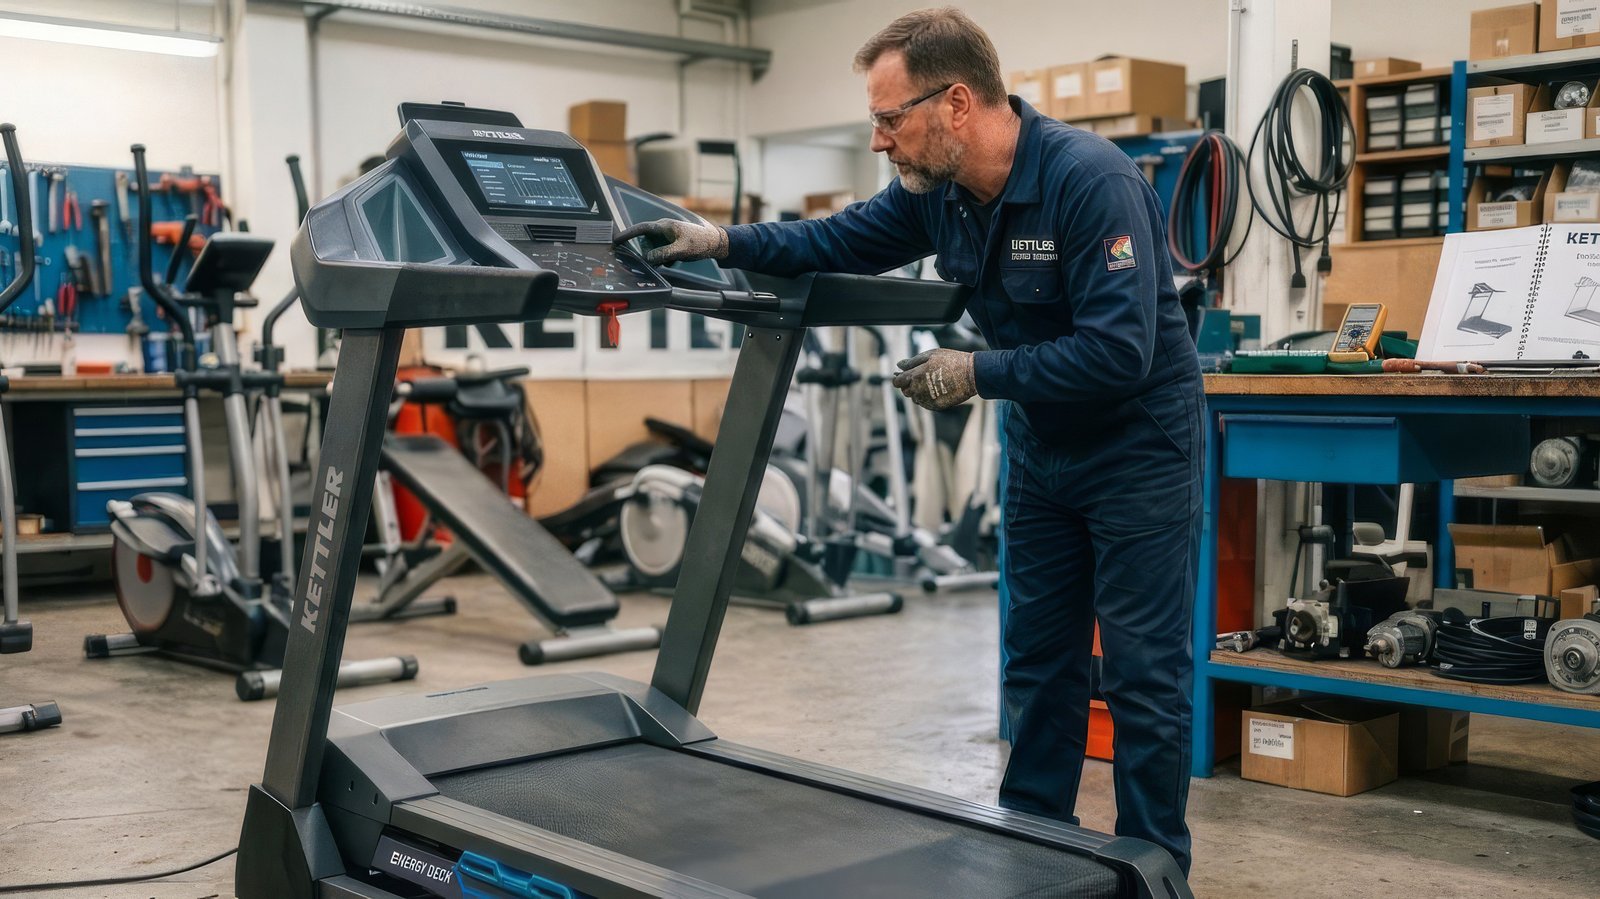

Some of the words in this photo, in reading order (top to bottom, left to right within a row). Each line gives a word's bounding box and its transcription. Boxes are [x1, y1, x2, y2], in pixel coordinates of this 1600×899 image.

[1567, 232, 1600, 245] KET
[301, 466, 344, 634] KETTLER
[390, 851, 427, 874] ENERGY
